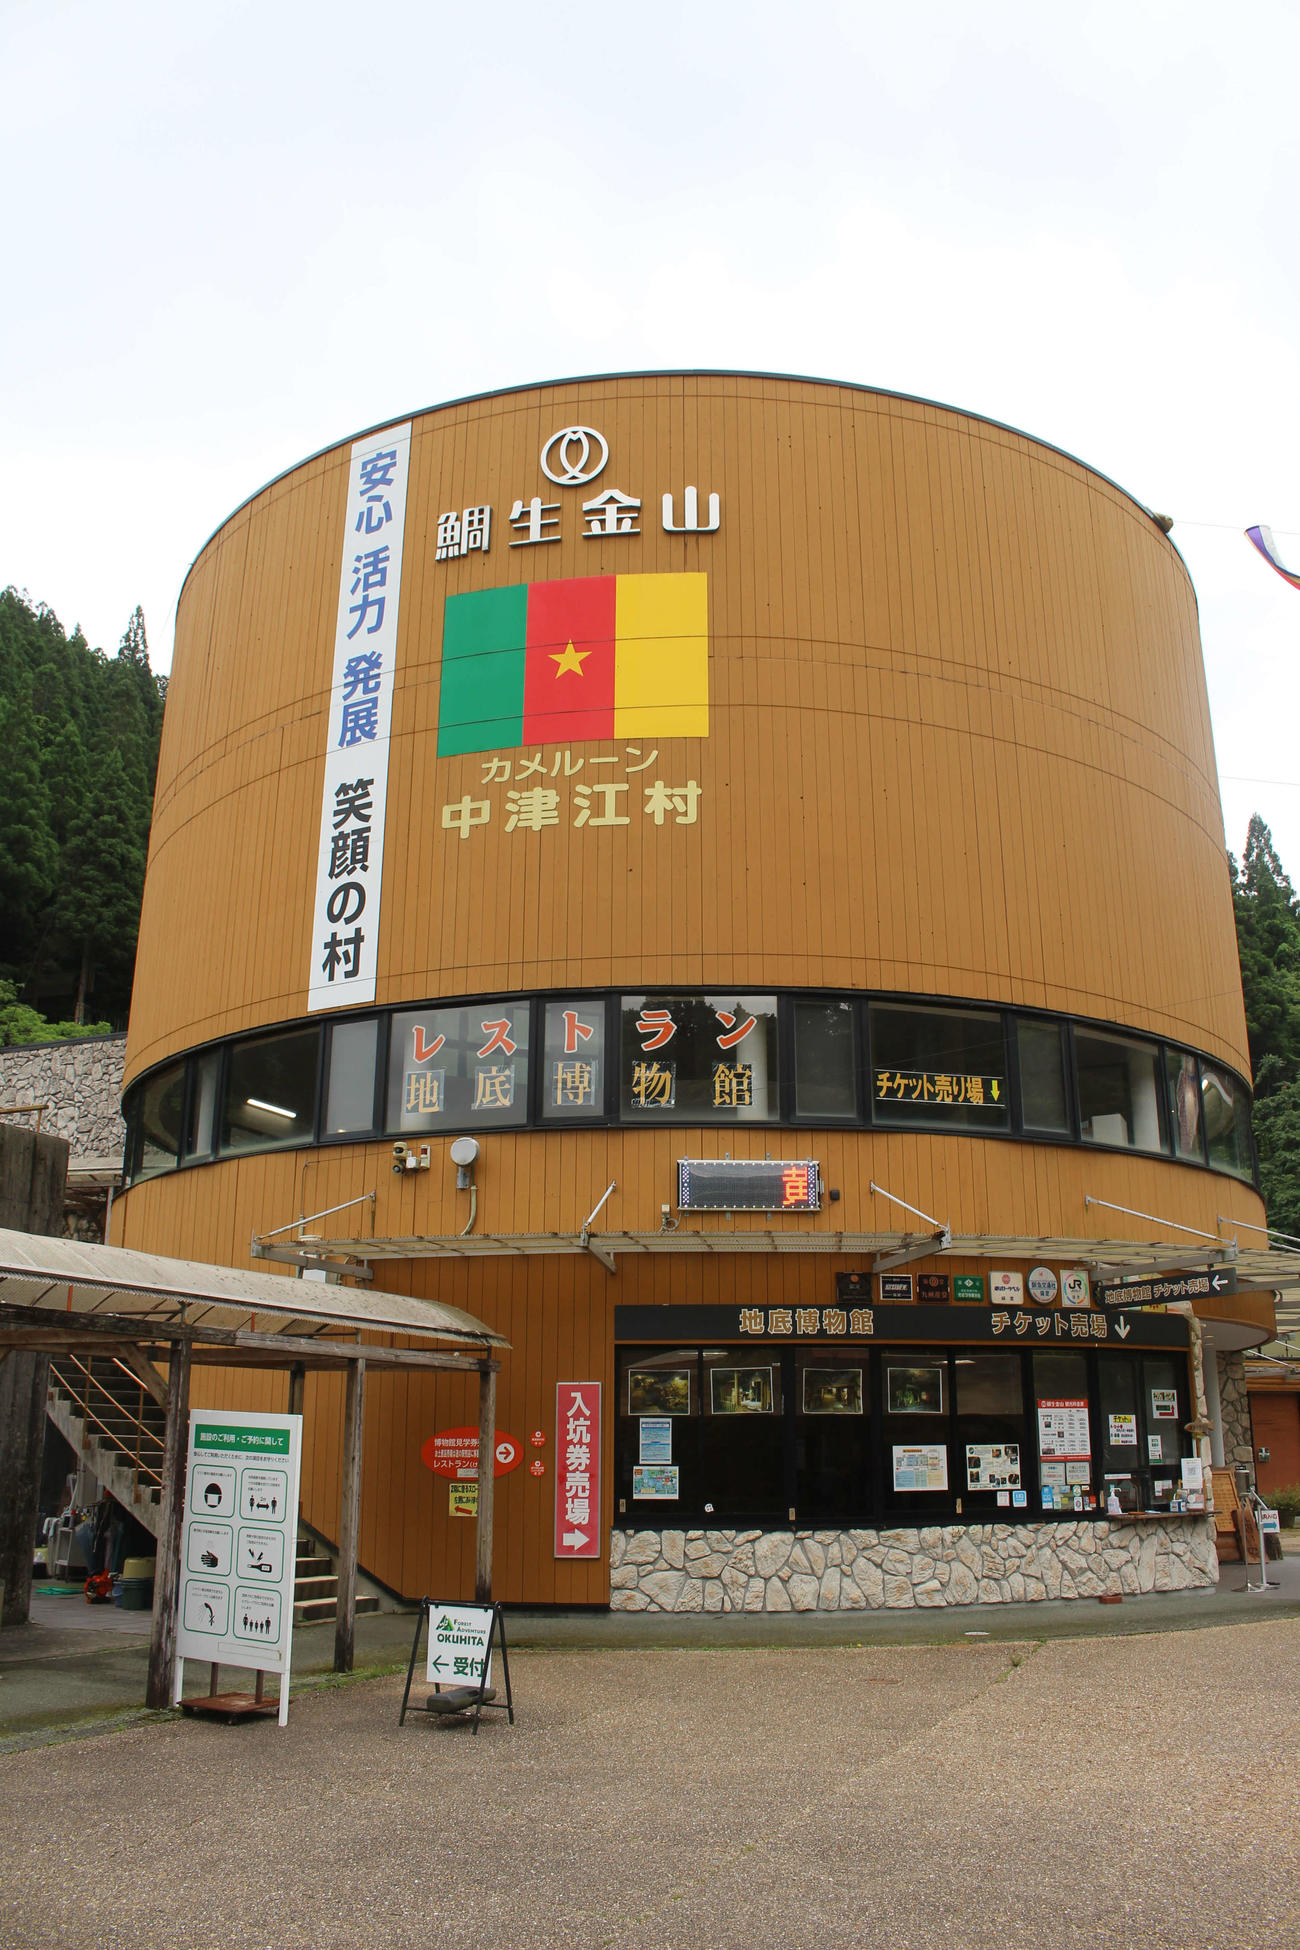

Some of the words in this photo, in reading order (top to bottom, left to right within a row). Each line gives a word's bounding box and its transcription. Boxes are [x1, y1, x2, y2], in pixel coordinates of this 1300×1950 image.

[355, 451, 398, 535] 安心
[434, 484, 721, 562] 鯛生金山
[346, 544, 391, 641] 活力
[337, 649, 383, 749] 発展
[480, 746, 659, 785] カメルーン
[441, 779, 703, 839] 中津江村
[321, 777, 375, 983] 笑顔の村
[411, 1009, 758, 1064] レストラン
[405, 1062, 754, 1114] 地底博物館
[876, 1072, 985, 1105] チケット売り場
[1068, 1279, 1083, 1290] JR
[1104, 1285, 1152, 1304] 地底博物館
[1153, 1277, 1210, 1298] チケット売場
[739, 1308, 874, 1335] 地底博物館
[991, 1311, 1108, 1338] チケット売場
[434, 1438, 480, 1447] 博物館見学券
[566, 1391, 592, 1525] 入坑券売場
[437, 1633, 485, 1647] OKUHITA
[456, 1626, 487, 1635] ADVENTURE
[453, 1656, 485, 1678] 受付
